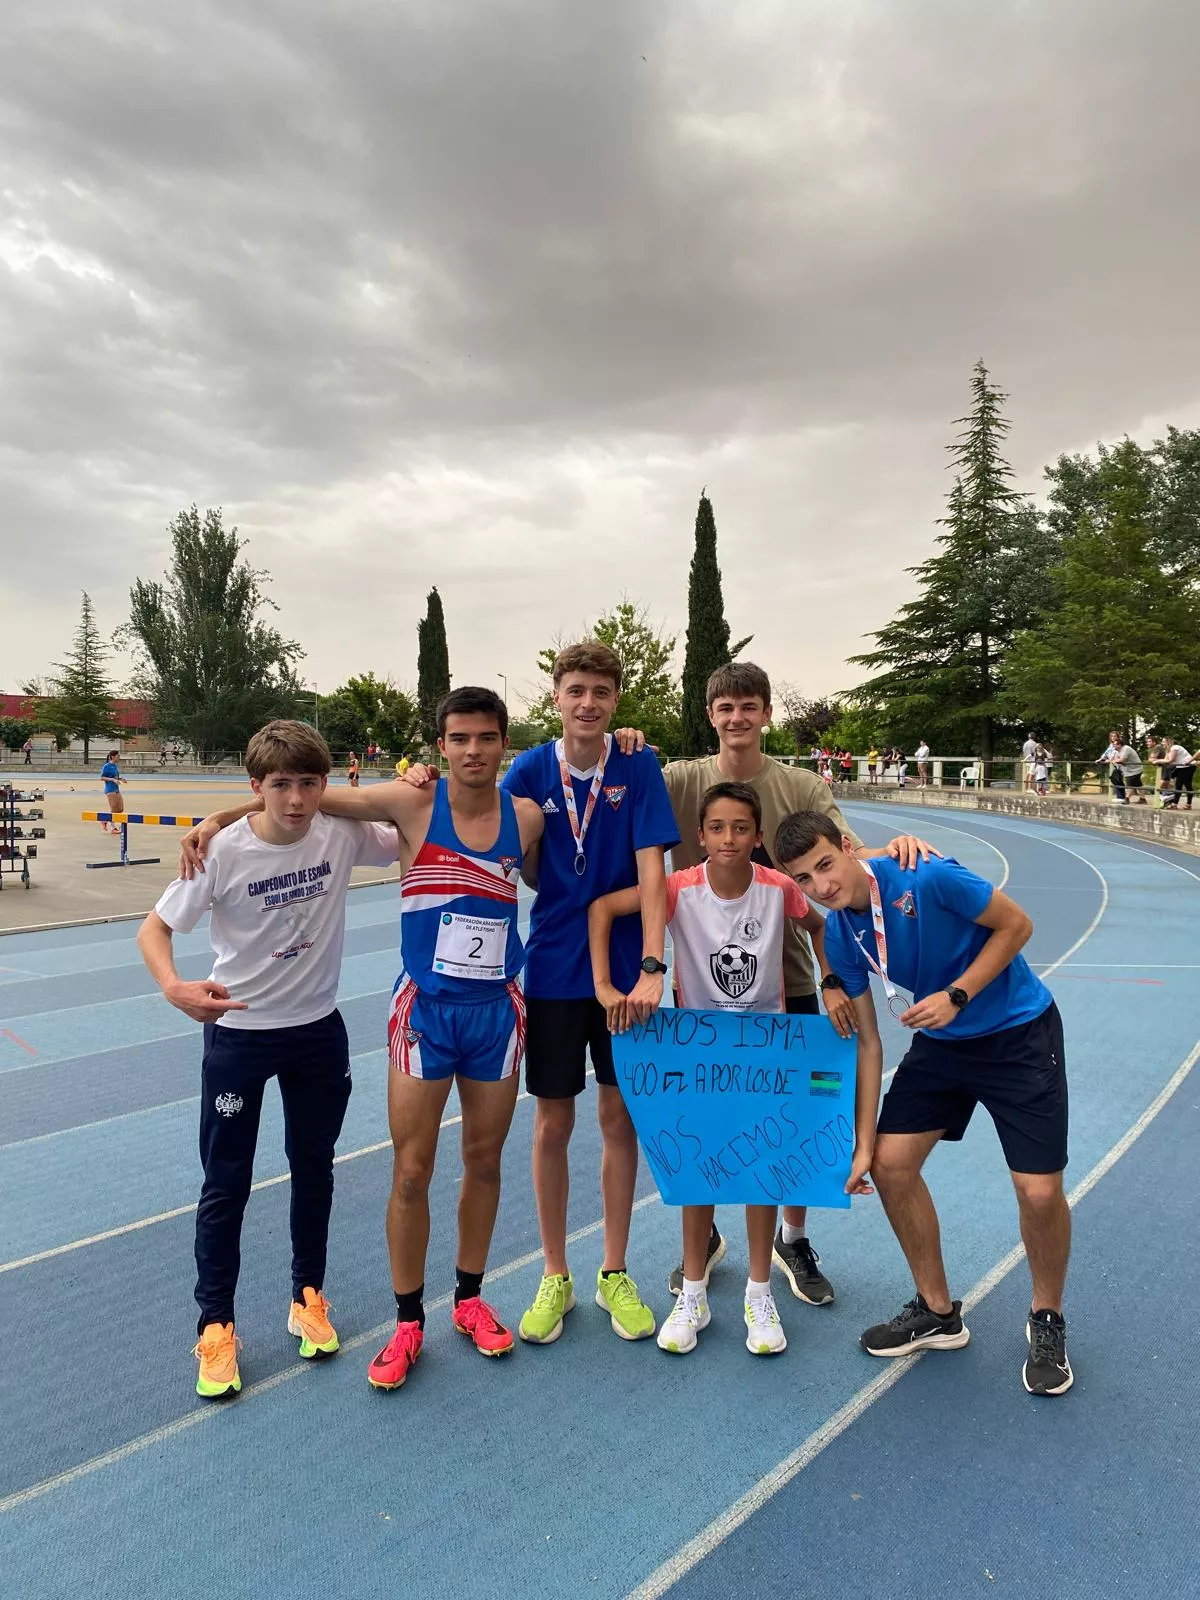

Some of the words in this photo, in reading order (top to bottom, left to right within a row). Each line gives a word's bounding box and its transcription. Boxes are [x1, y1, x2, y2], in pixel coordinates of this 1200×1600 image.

[248, 872, 298, 897] CAMPEONATO
[298, 869, 308, 884] DE
[308, 860, 332, 882] ESPAÑA
[264, 892, 282, 906] ESQUÍ
[282, 891, 289, 903] DE
[454, 916, 482, 925] FEDERACIÓN
[468, 936, 484, 959] 2
[630, 1011, 717, 1046] VAMOS
[733, 1015, 807, 1051] ISMA
[624, 1062, 658, 1096] 400
[695, 1063, 706, 1093] A
[711, 1063, 742, 1093] POR
[745, 1066, 772, 1093] LOS
[773, 1067, 799, 1095] DE
[644, 1115, 702, 1177] NOS
[698, 1102, 799, 1192] HACEMOS
